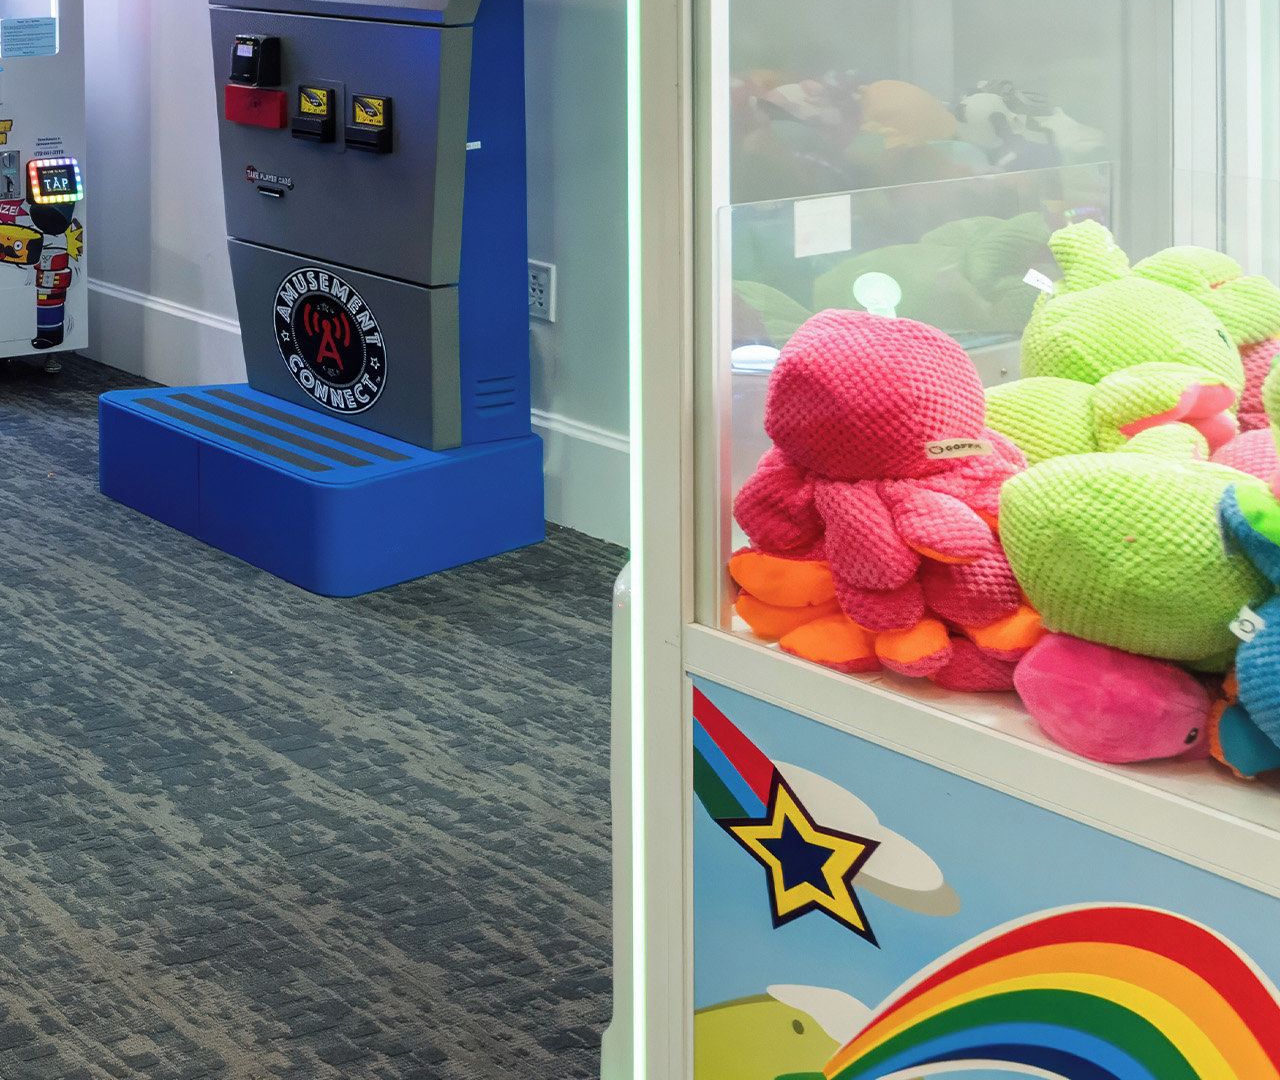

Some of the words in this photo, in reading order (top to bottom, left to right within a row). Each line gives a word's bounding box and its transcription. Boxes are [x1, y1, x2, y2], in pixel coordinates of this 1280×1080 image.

[43, 177, 68, 190] TAP
[276, 271, 382, 348] AMUSEMENT
[290, 354, 378, 408] CONNECT
